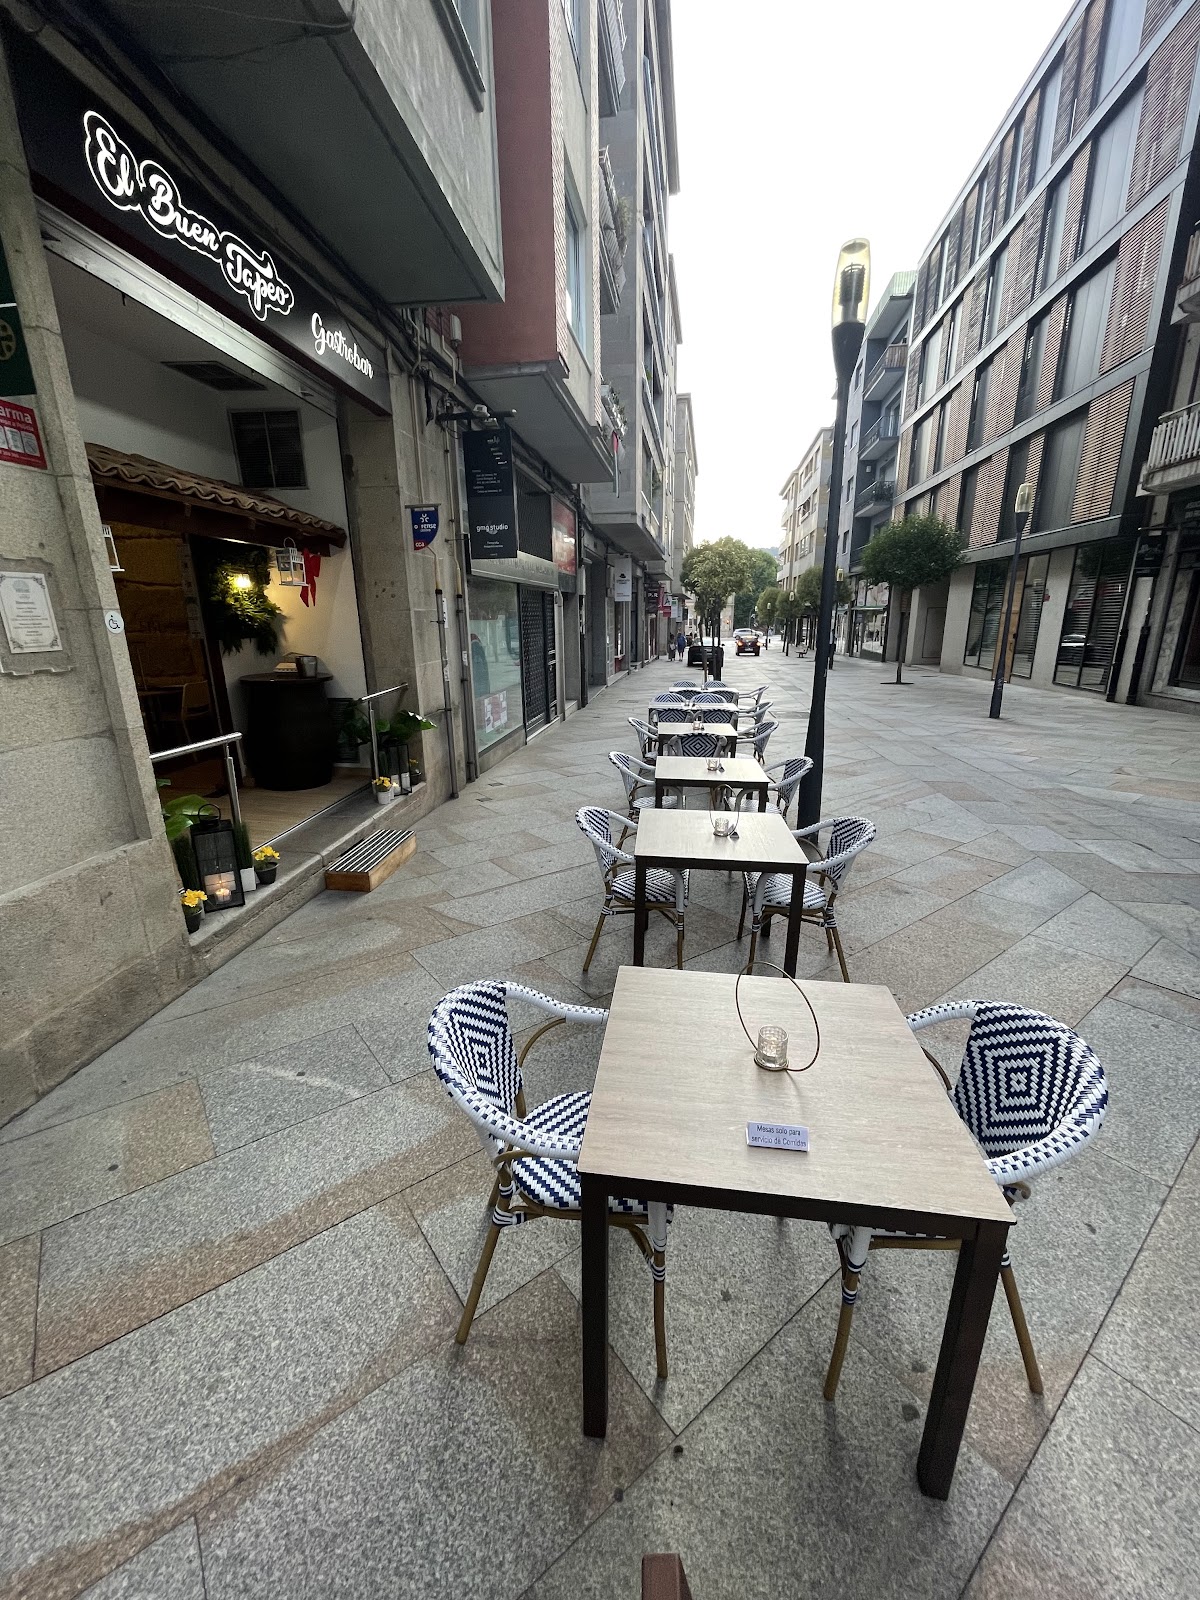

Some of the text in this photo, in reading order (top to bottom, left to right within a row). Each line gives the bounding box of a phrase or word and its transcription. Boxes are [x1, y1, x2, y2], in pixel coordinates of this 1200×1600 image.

[96, 127, 290, 312] El Buen Tapeo
[311, 312, 374, 379] Gastrobar
[756, 1125, 775, 1133] Mesas
[775, 1127, 787, 1135] solo
[773, 1137, 782, 1145] de
